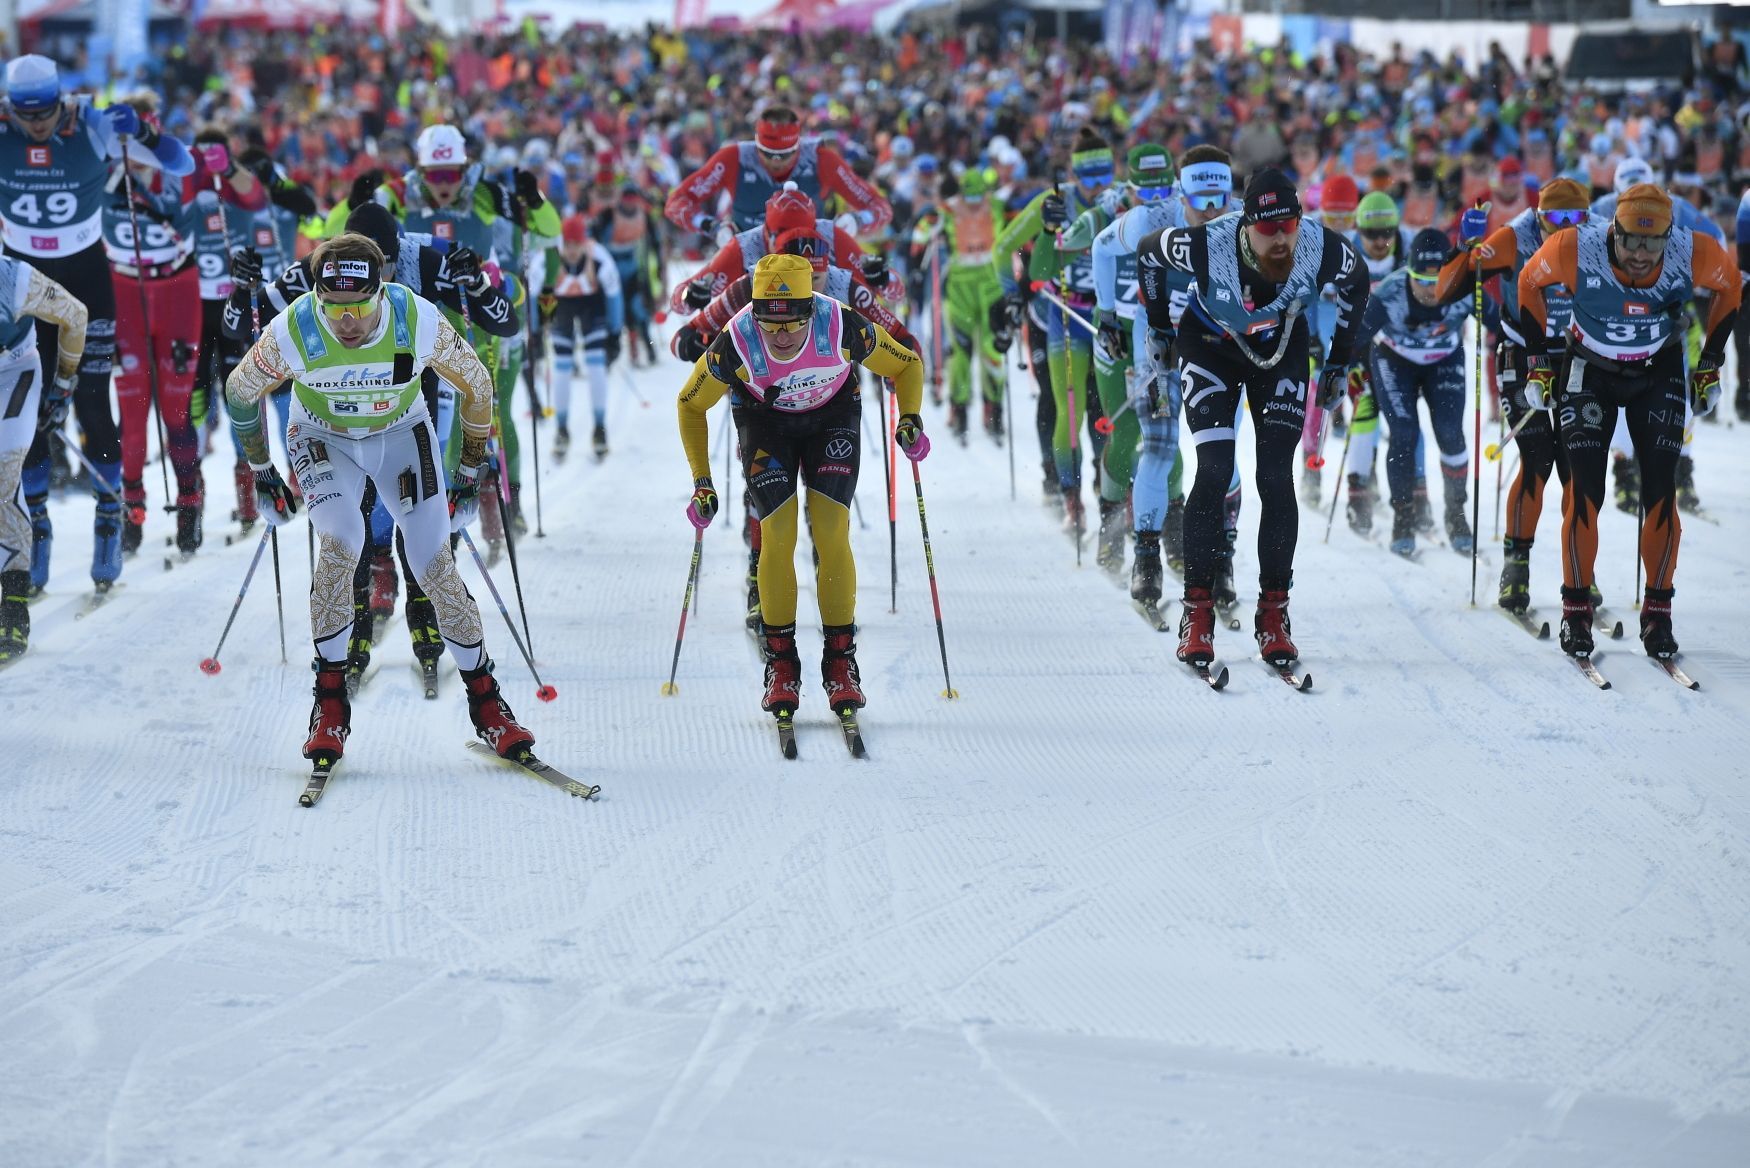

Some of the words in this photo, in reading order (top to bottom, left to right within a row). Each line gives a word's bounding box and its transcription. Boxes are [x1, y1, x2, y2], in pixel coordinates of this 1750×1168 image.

[10, 191, 78, 224] 49
[1261, 207, 1290, 219] Moelven
[325, 262, 367, 271] Cmfort
[1171, 232, 1194, 273] 157
[1334, 242, 1355, 280] 157
